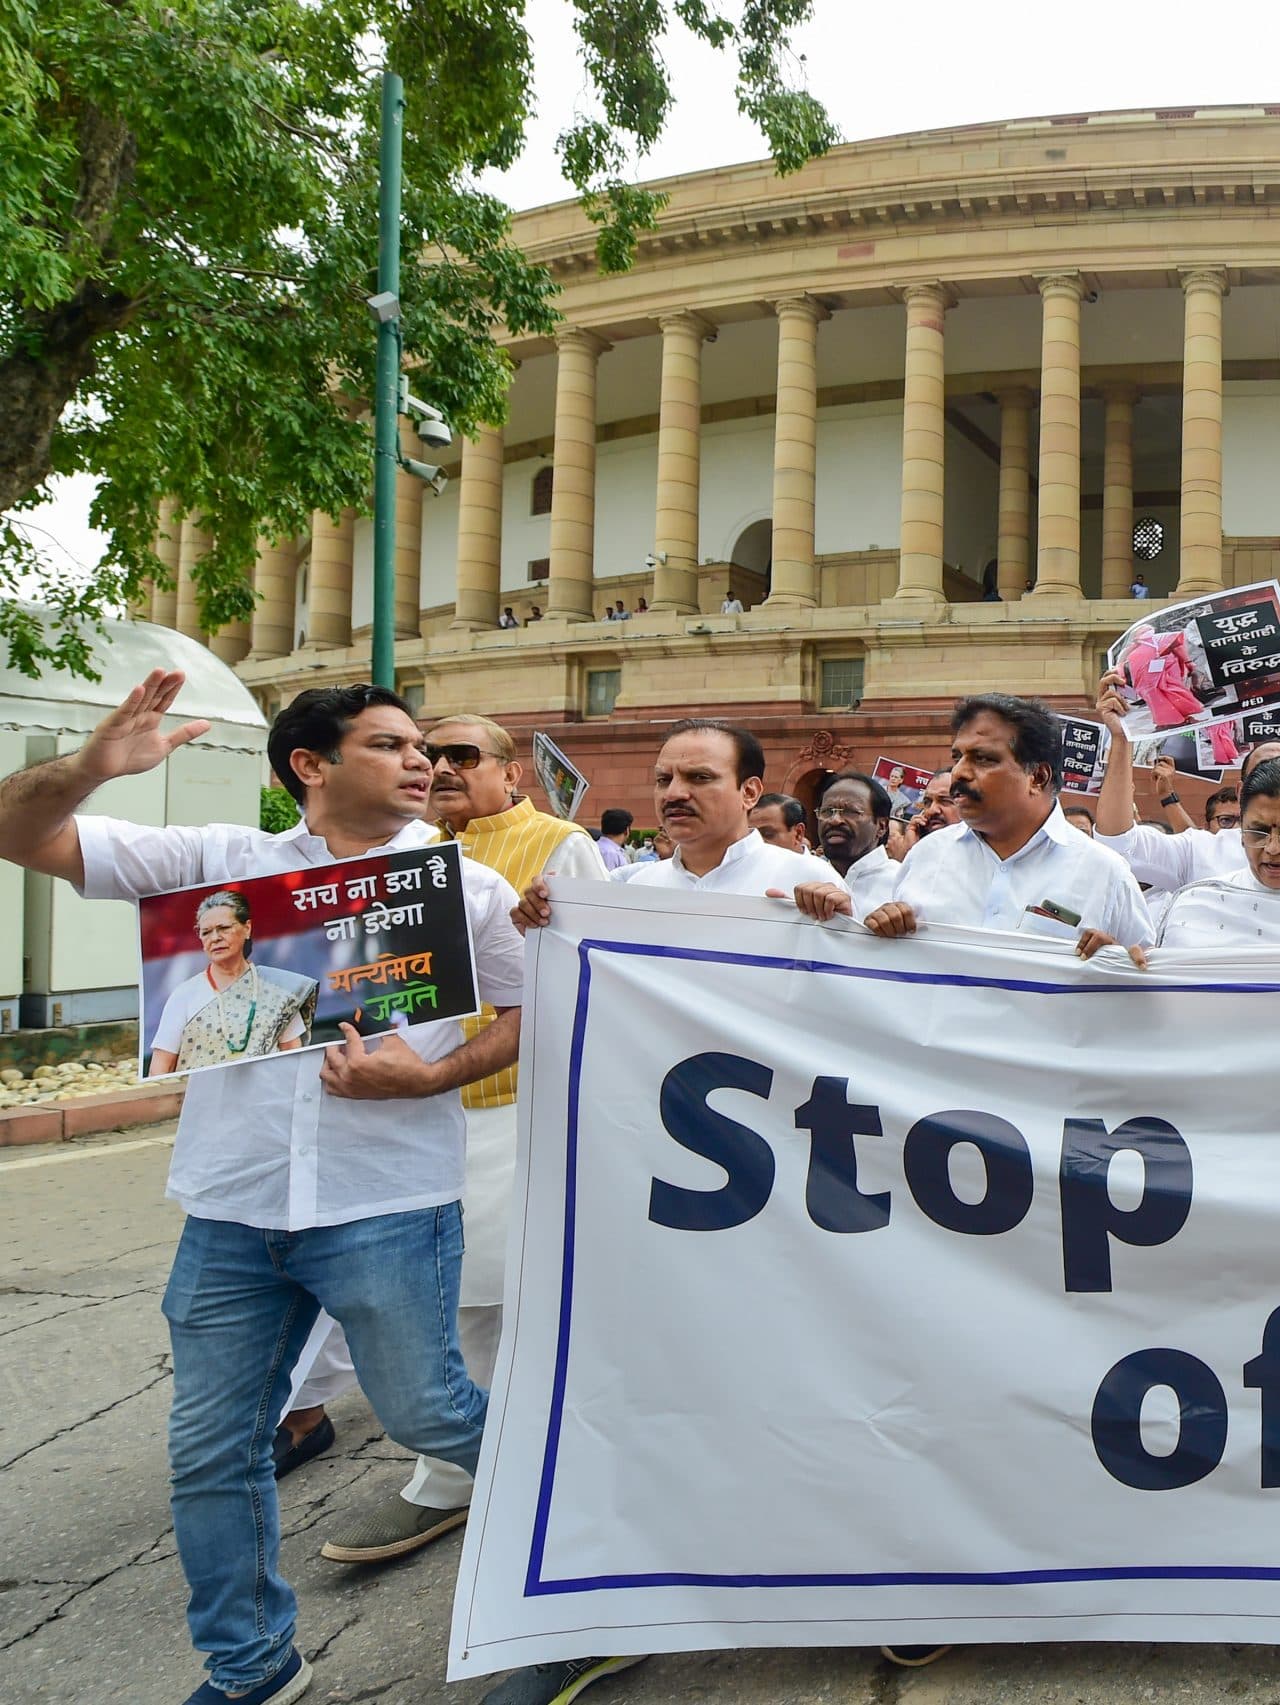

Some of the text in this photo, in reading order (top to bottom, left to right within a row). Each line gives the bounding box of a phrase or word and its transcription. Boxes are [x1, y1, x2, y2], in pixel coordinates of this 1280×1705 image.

[1213, 611, 1258, 633] युद्ध
[1208, 625, 1275, 647] तानाशाही
[1241, 646, 1257, 655] के
[1242, 696, 1264, 708] #ED
[1073, 728, 1093, 741] युद्ध
[1064, 757, 1093, 772] विरुद्ध
[292, 855, 447, 910] सच ना डरा है
[324, 902, 424, 941] ना डरेगा
[648, 1052, 1192, 1294] Stop
